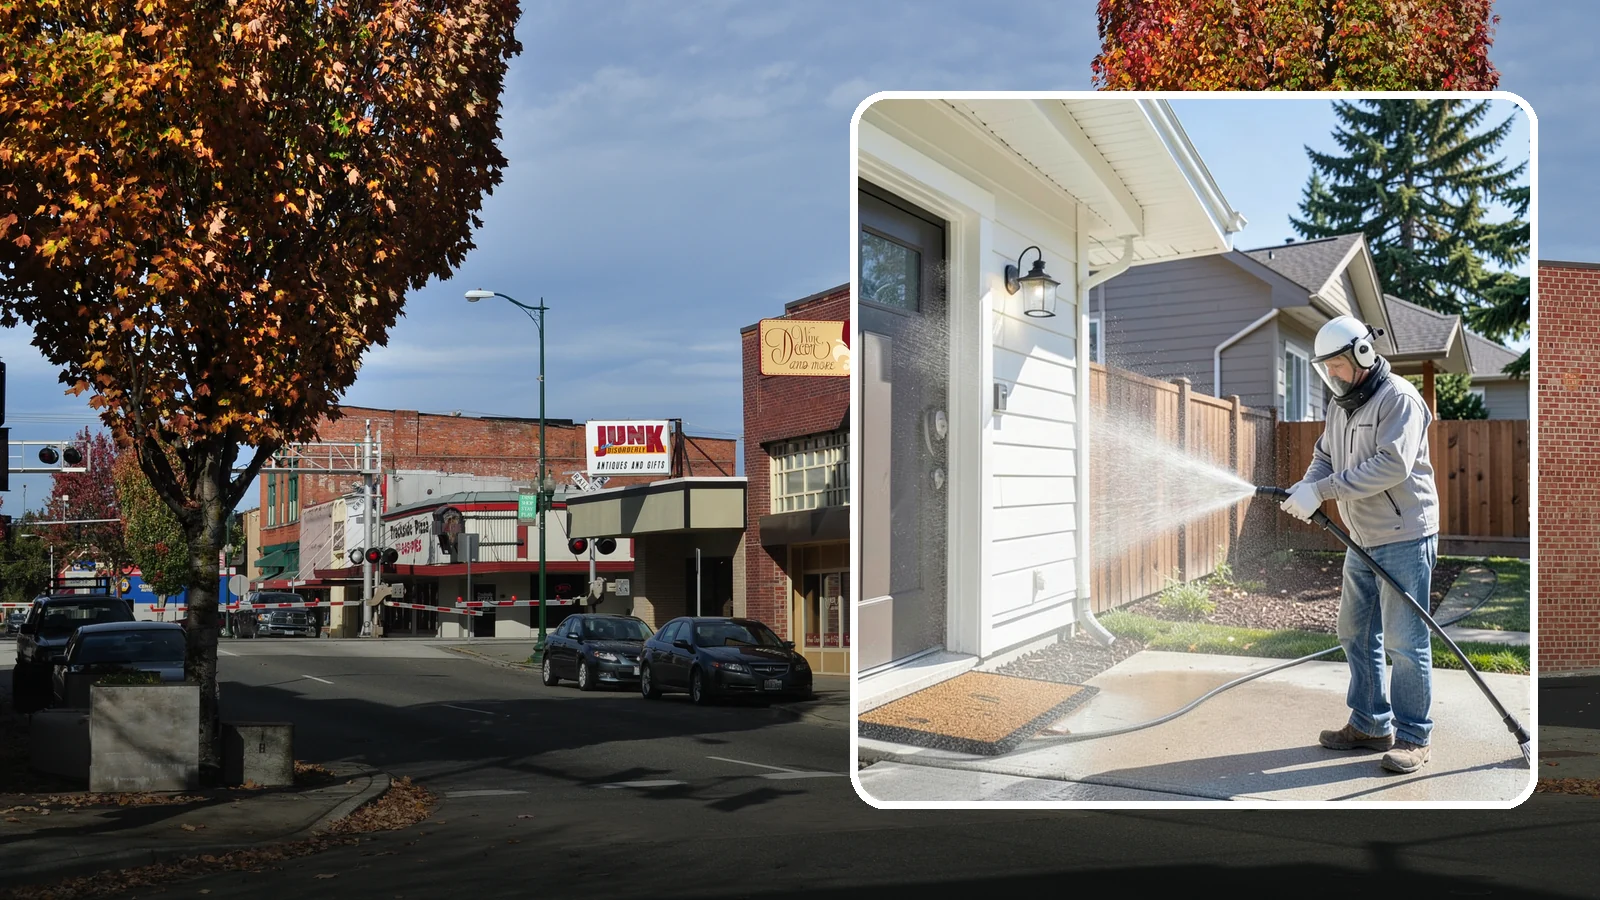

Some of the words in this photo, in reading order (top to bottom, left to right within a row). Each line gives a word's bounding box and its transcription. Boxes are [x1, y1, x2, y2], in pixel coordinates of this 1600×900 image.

[596, 425, 664, 457] JUNK
[607, 446, 646, 454] DISORDERLY
[596, 461, 628, 470] ANTIQUES
[631, 461, 644, 470] AND
[646, 460, 665, 469] GIFTS
[414, 519, 429, 535] Pizza
